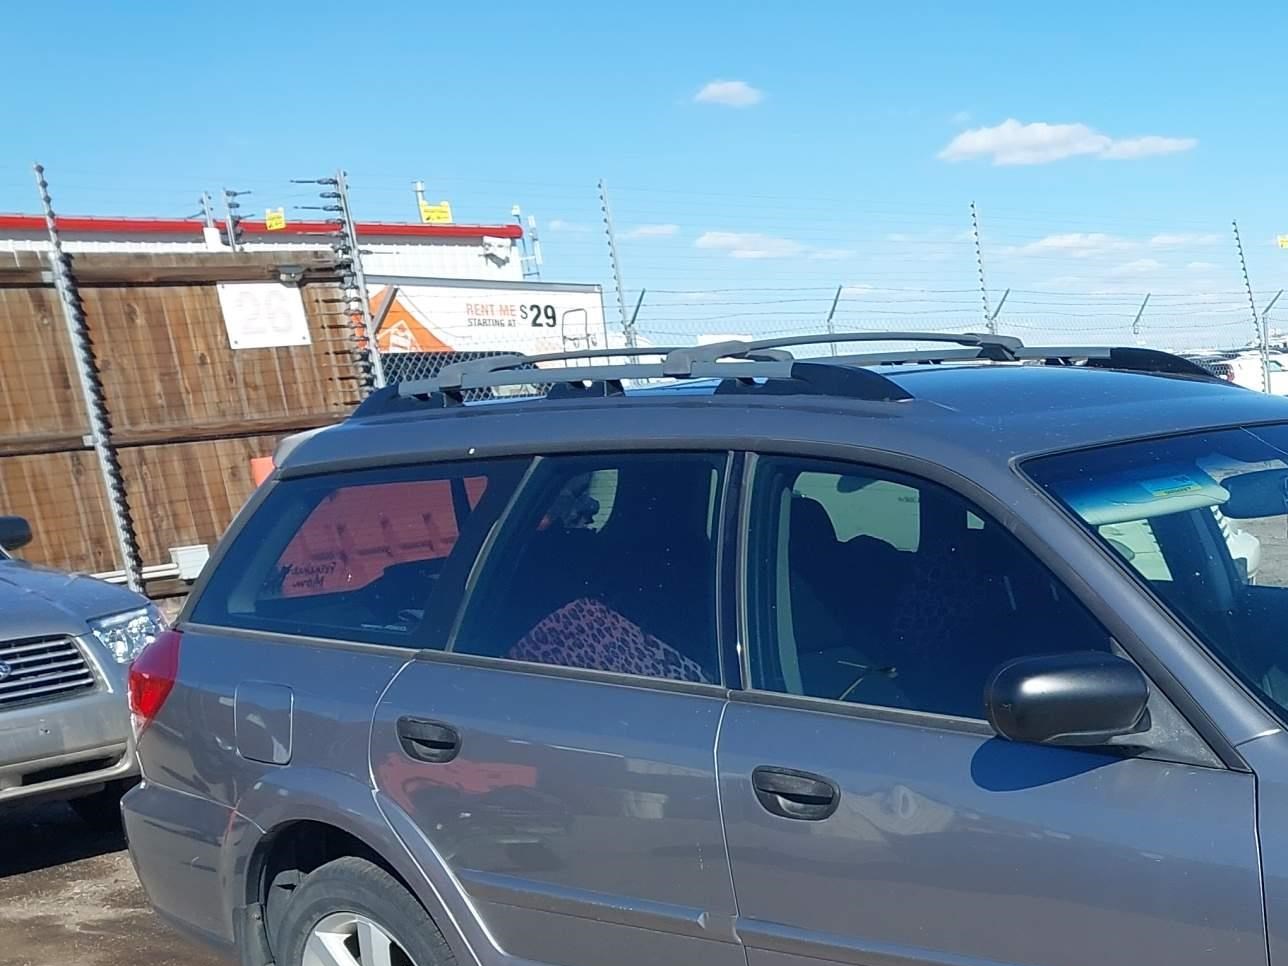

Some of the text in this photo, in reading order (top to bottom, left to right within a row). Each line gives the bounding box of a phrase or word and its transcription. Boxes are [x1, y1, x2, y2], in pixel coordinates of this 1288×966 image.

[466, 303, 494, 316] RENT
[499, 304, 517, 316] ME
[467, 318, 517, 328] STARTING AT
